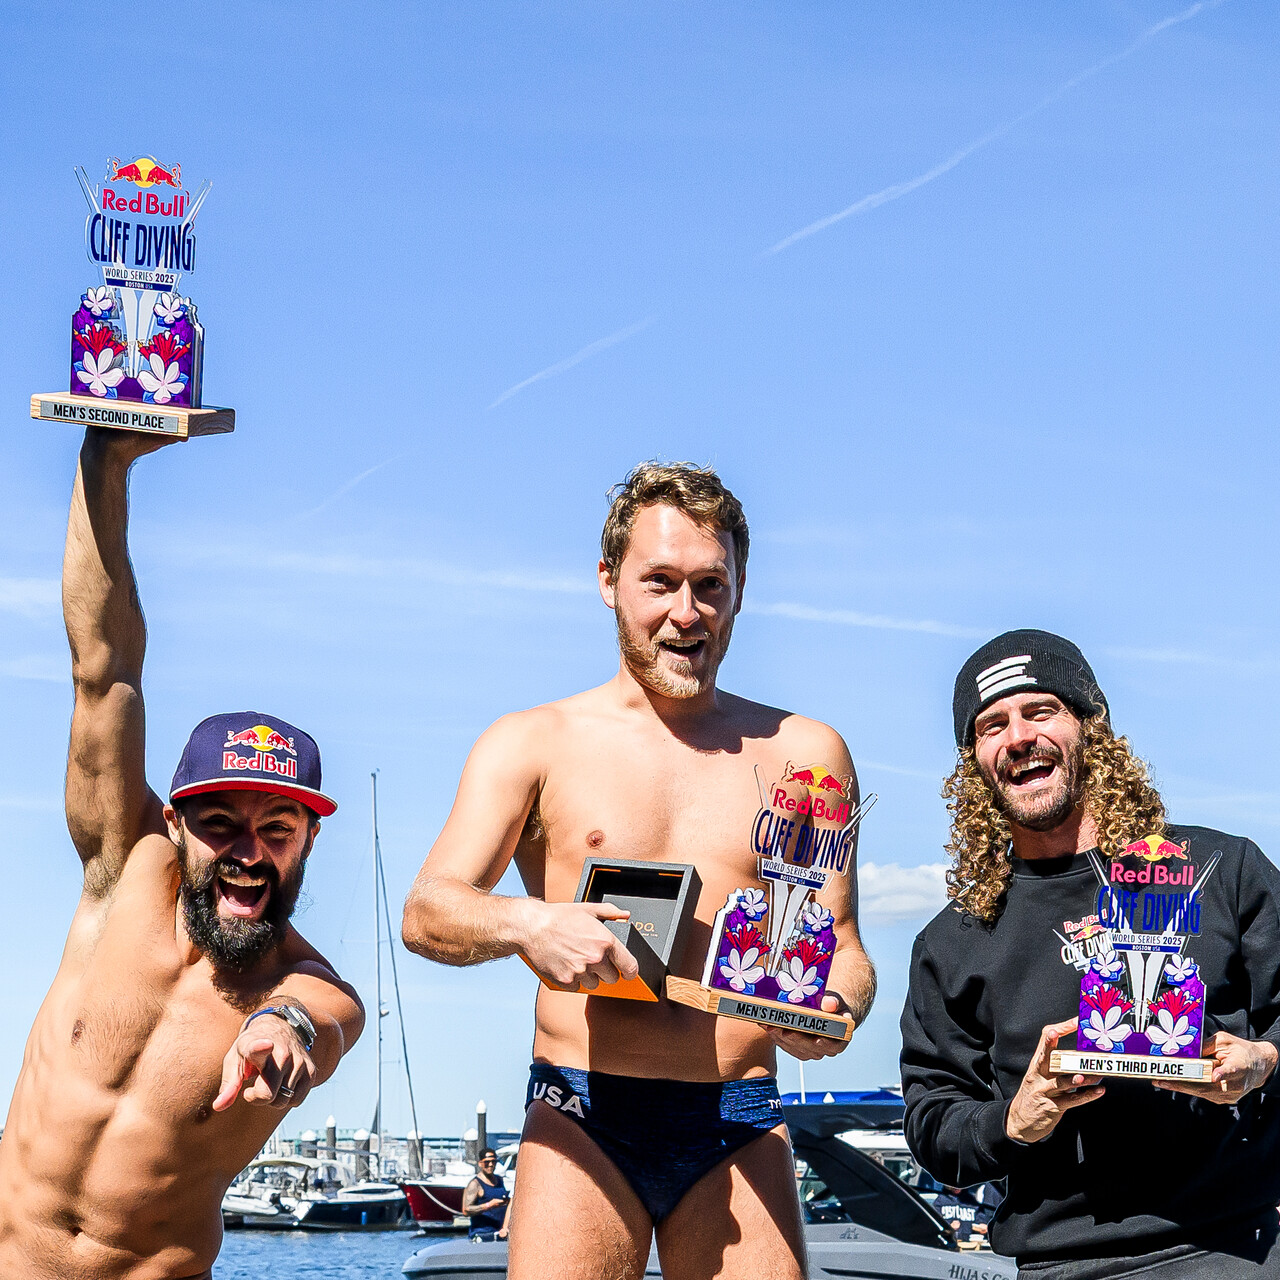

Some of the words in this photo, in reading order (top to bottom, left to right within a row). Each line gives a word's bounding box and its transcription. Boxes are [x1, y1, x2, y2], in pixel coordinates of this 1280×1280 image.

[102, 189, 142, 214] Red
[145, 192, 185, 217] Bull
[90, 214, 130, 264] CLIFF
[135, 222, 192, 271] DIVING
[105, 267, 128, 279] WORLD
[130, 270, 153, 281] SERIES
[155, 273, 174, 284] 2025
[53, 404, 86, 420] MEN'S
[89, 407, 129, 425] SECOND
[131, 411, 164, 429] PLACE
[223, 751, 262, 770] Red
[263, 752, 298, 778] Bull
[772, 788, 811, 816] Red
[812, 797, 850, 824] Bull
[754, 809, 793, 859] CLIFF
[794, 824, 849, 873] DIVING
[763, 860, 785, 872] WORLD
[786, 865, 807, 878] SERIES
[809, 871, 826, 881] 2025
[1110, 862, 1151, 885] Red
[1154, 864, 1194, 886] Bull
[1063, 917, 1086, 933] Red
[1087, 908, 1108, 925] Bul
[1097, 885, 1138, 929] CLIFF
[1143, 889, 1201, 934] DIVING
[1112, 933, 1135, 943] WORLD
[1138, 935, 1160, 944] SERIES
[1163, 936, 1181, 945] 2025
[735, 1002, 768, 1020] MEN'S
[769, 1008, 797, 1026] FIRST
[797, 1013, 829, 1032] PLACE
[1079, 1057, 1113, 1071] MEN'S
[1116, 1059, 1148, 1073] THIRD
[1150, 1061, 1184, 1076] PLACE
[533, 1082, 585, 1119] USA
